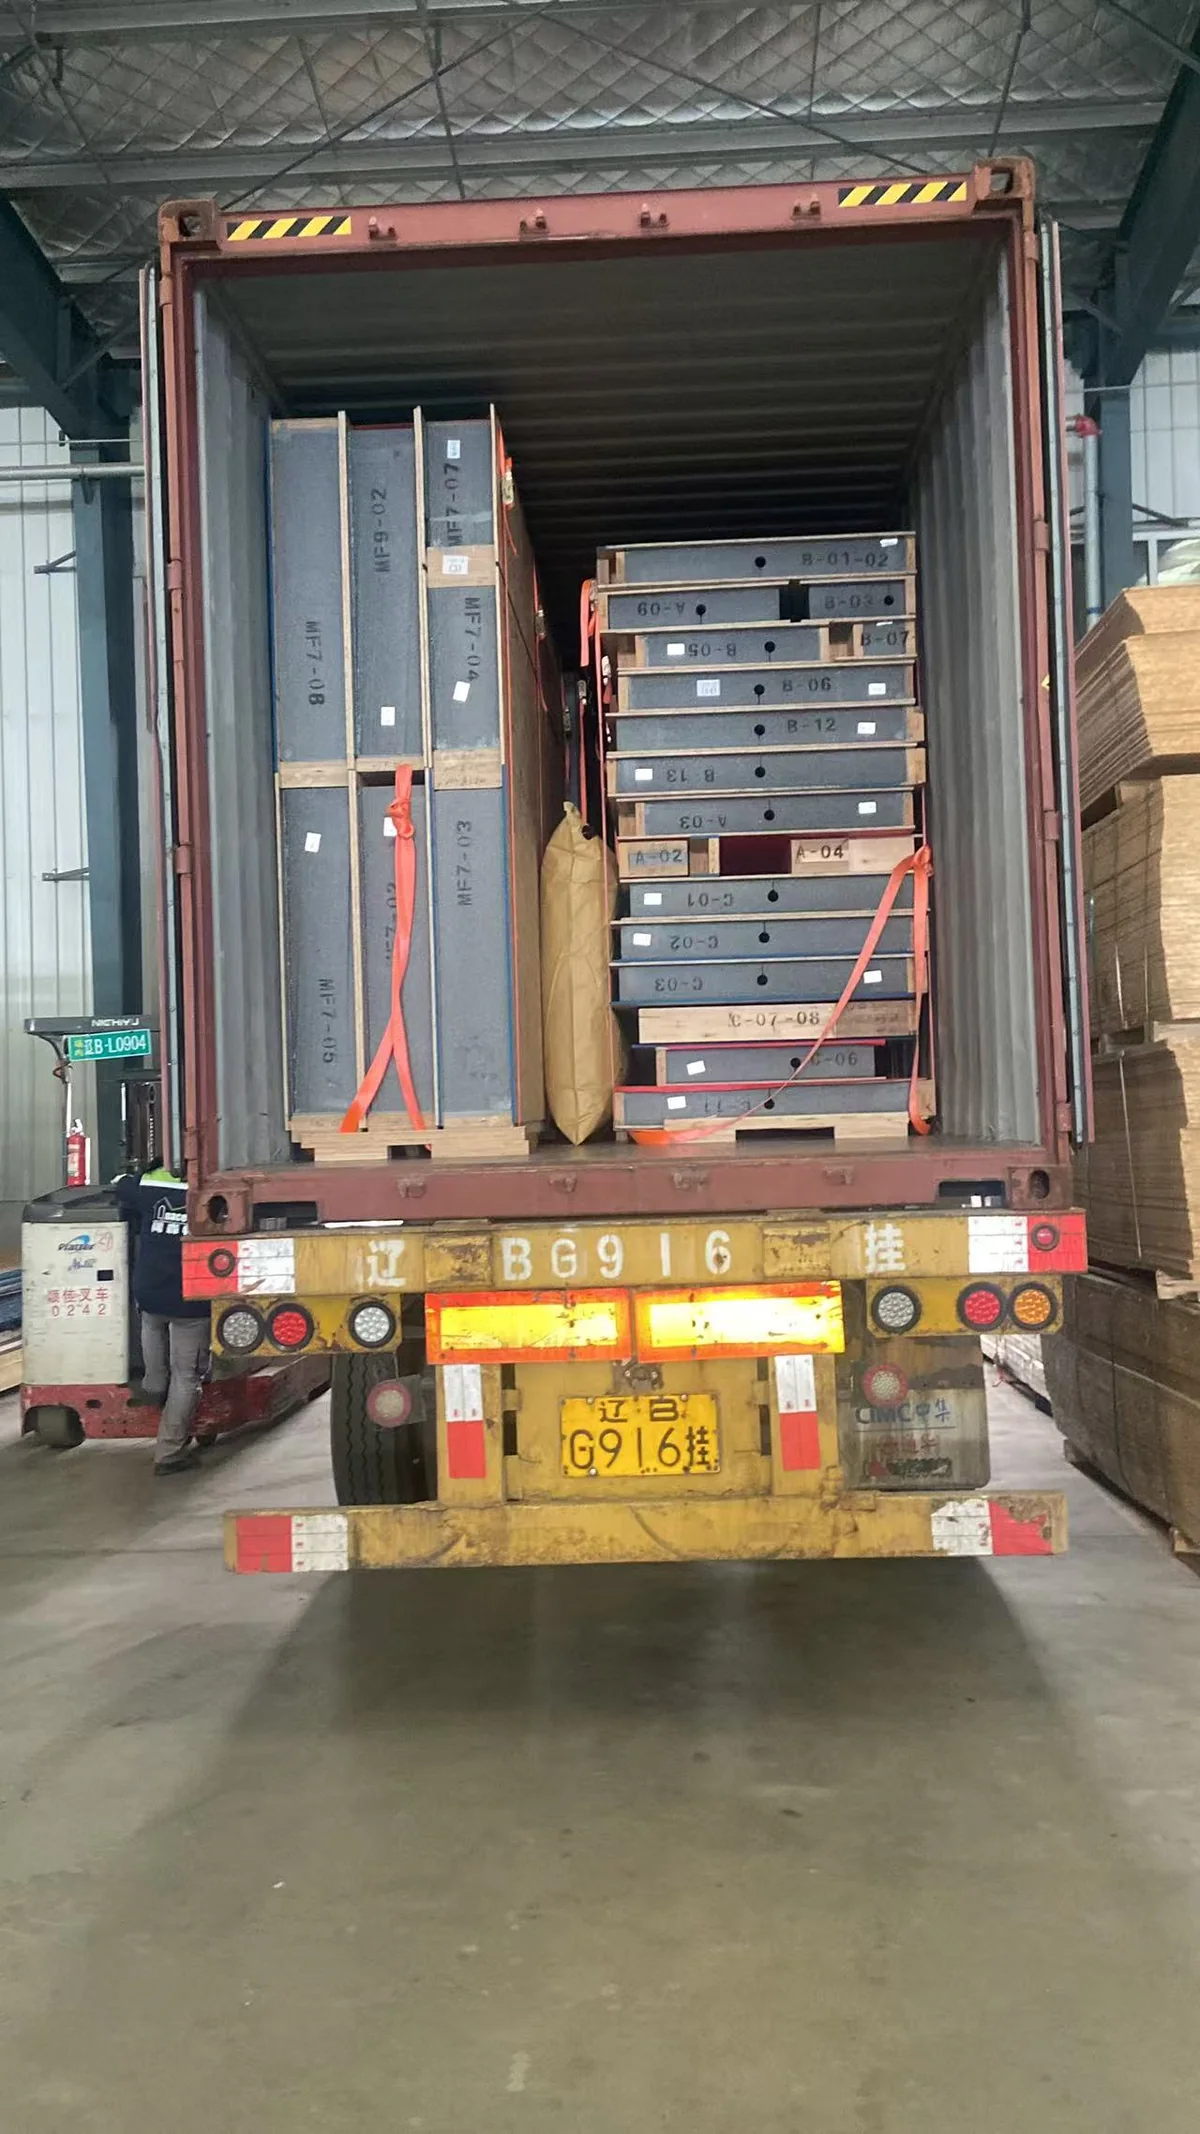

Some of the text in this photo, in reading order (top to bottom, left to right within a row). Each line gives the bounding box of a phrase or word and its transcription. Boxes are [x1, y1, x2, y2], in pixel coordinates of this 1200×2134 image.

[370, 488, 389, 574] MF9-02
[802, 552, 888, 568] B-01-02
[637, 601, 685, 615] A-09
[465, 597, 481, 682] MF7-04
[861, 630, 909, 646] B-07
[688, 643, 737, 658] B-05
[782, 677, 831, 692] B-06
[787, 718, 837, 733] B-12
[680, 815, 726, 829] A-03
[635, 850, 683, 863] A-02
[796, 845, 844, 860] A-04
[457, 821, 473, 906] MF7-03
[687, 893, 734, 907] C-01
[670, 935, 719, 949] C-02
[655, 977, 703, 991] C-03
[319, 979, 336, 1064] MF7-05
[731, 1011, 820, 1027] C-07-08
[570, 1426, 709, 1469] G916挂
